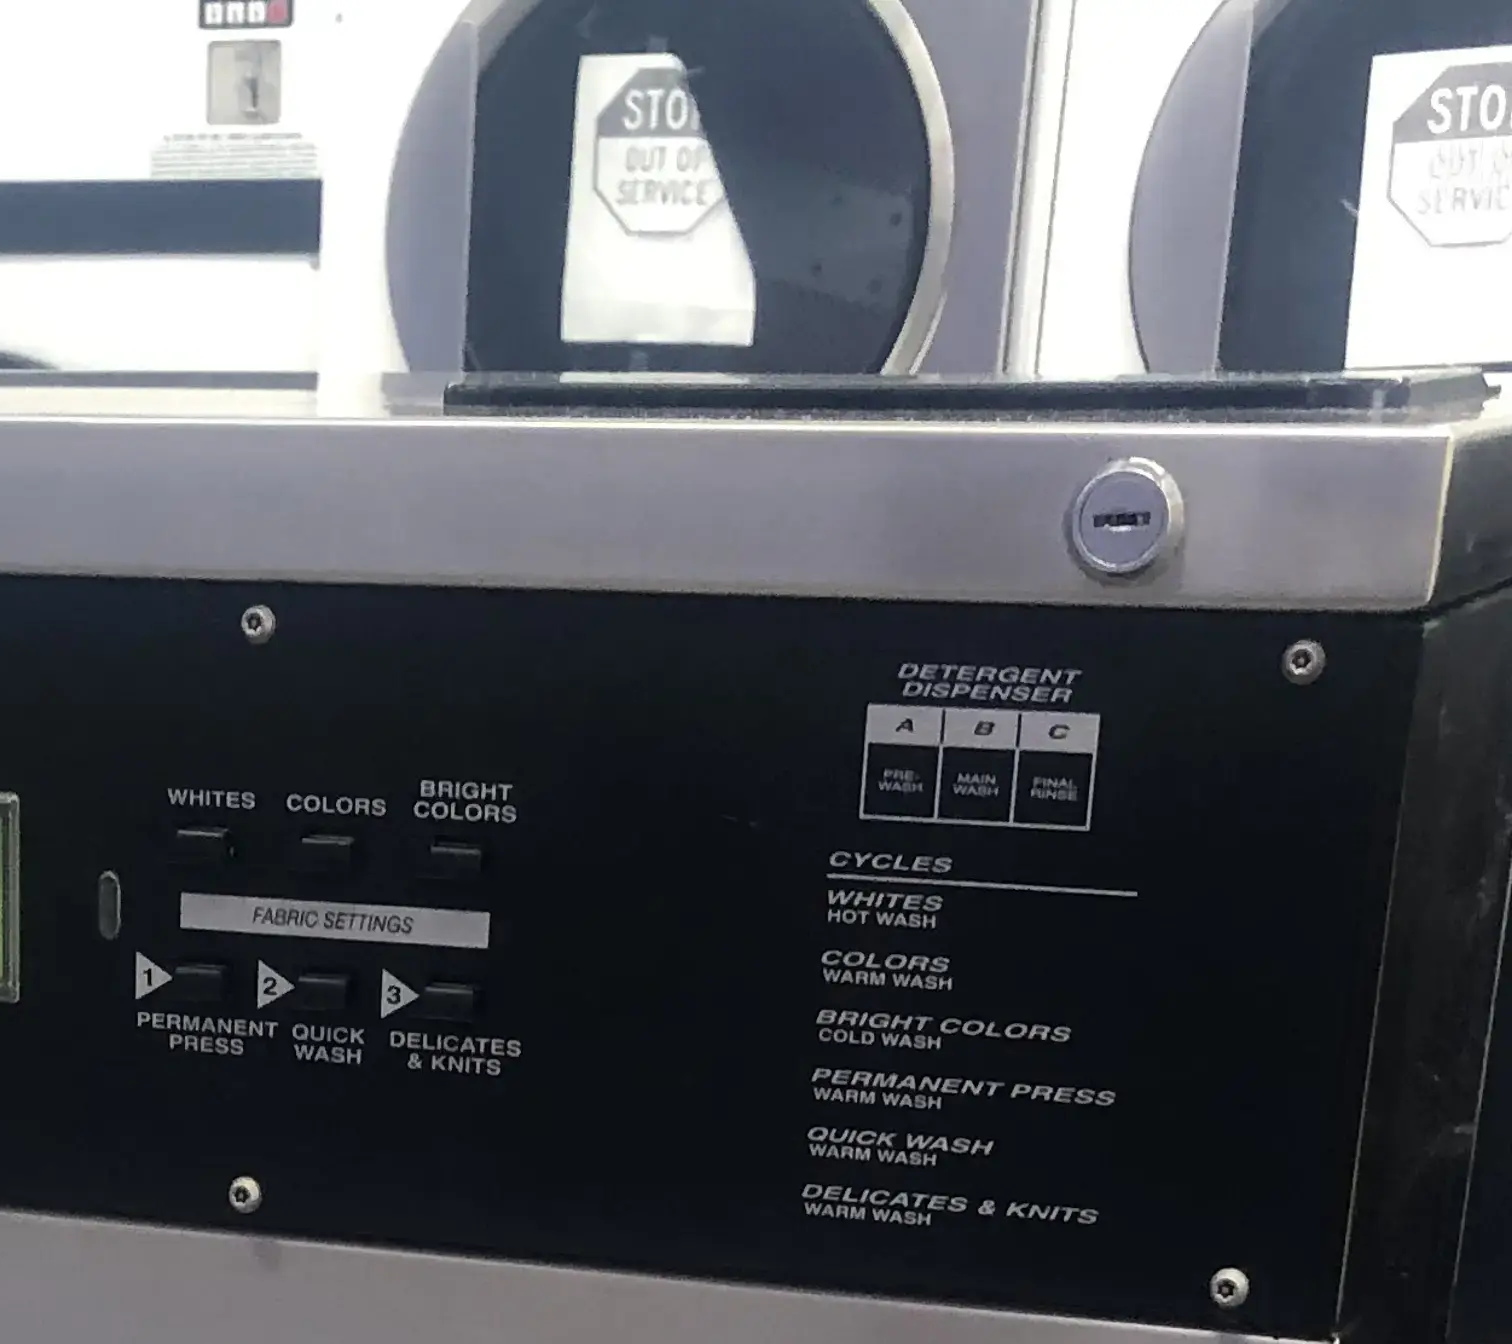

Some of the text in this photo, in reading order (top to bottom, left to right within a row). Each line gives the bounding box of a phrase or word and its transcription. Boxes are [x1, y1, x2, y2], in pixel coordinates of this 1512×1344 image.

[1426, 84, 1512, 135] STO
[624, 145, 668, 173] OUT
[615, 179, 711, 207] SERVICE
[897, 662, 1083, 686] DETERGENT
[902, 680, 1073, 703] DISPENSER
[895, 718, 1071, 740] A B C
[878, 780, 924, 793] WASH
[952, 783, 1000, 797] WASH
[956, 772, 997, 785] MAIN
[1032, 776, 1077, 789] FINAL
[167, 787, 257, 811] WHITES
[419, 779, 514, 803] BRIGHT
[286, 793, 388, 817] COLORS
[413, 800, 518, 824] COLORS
[828, 850, 954, 874] CYCLES
[827, 889, 944, 912] WHITES
[251, 905, 415, 935] FABRIC SETTINGS
[826, 908, 938, 929] HOT WASH
[820, 949, 951, 973] COLORS
[142, 967, 402, 1006] 1 2 3
[822, 967, 954, 991] WARM WASH
[136, 1011, 279, 1040] PERMANENT
[291, 1022, 366, 1046] QUICK
[815, 1008, 1073, 1044] BRIGHT COLORS
[168, 1033, 245, 1057] PRESS
[388, 1030, 523, 1059] DELICATES
[818, 1027, 943, 1051] COLD WASH
[293, 1043, 363, 1066] WASH
[407, 1054, 503, 1077] & KNITS
[810, 1066, 1117, 1107] PERMANENT PRESS
[813, 1086, 943, 1111] WARM WASH
[806, 1125, 995, 1157] QUICK WASH
[808, 1143, 938, 1168] WARM WASH
[800, 1182, 1100, 1226] DELICATES & KNITS
[803, 1201, 933, 1227] WARM WASH
